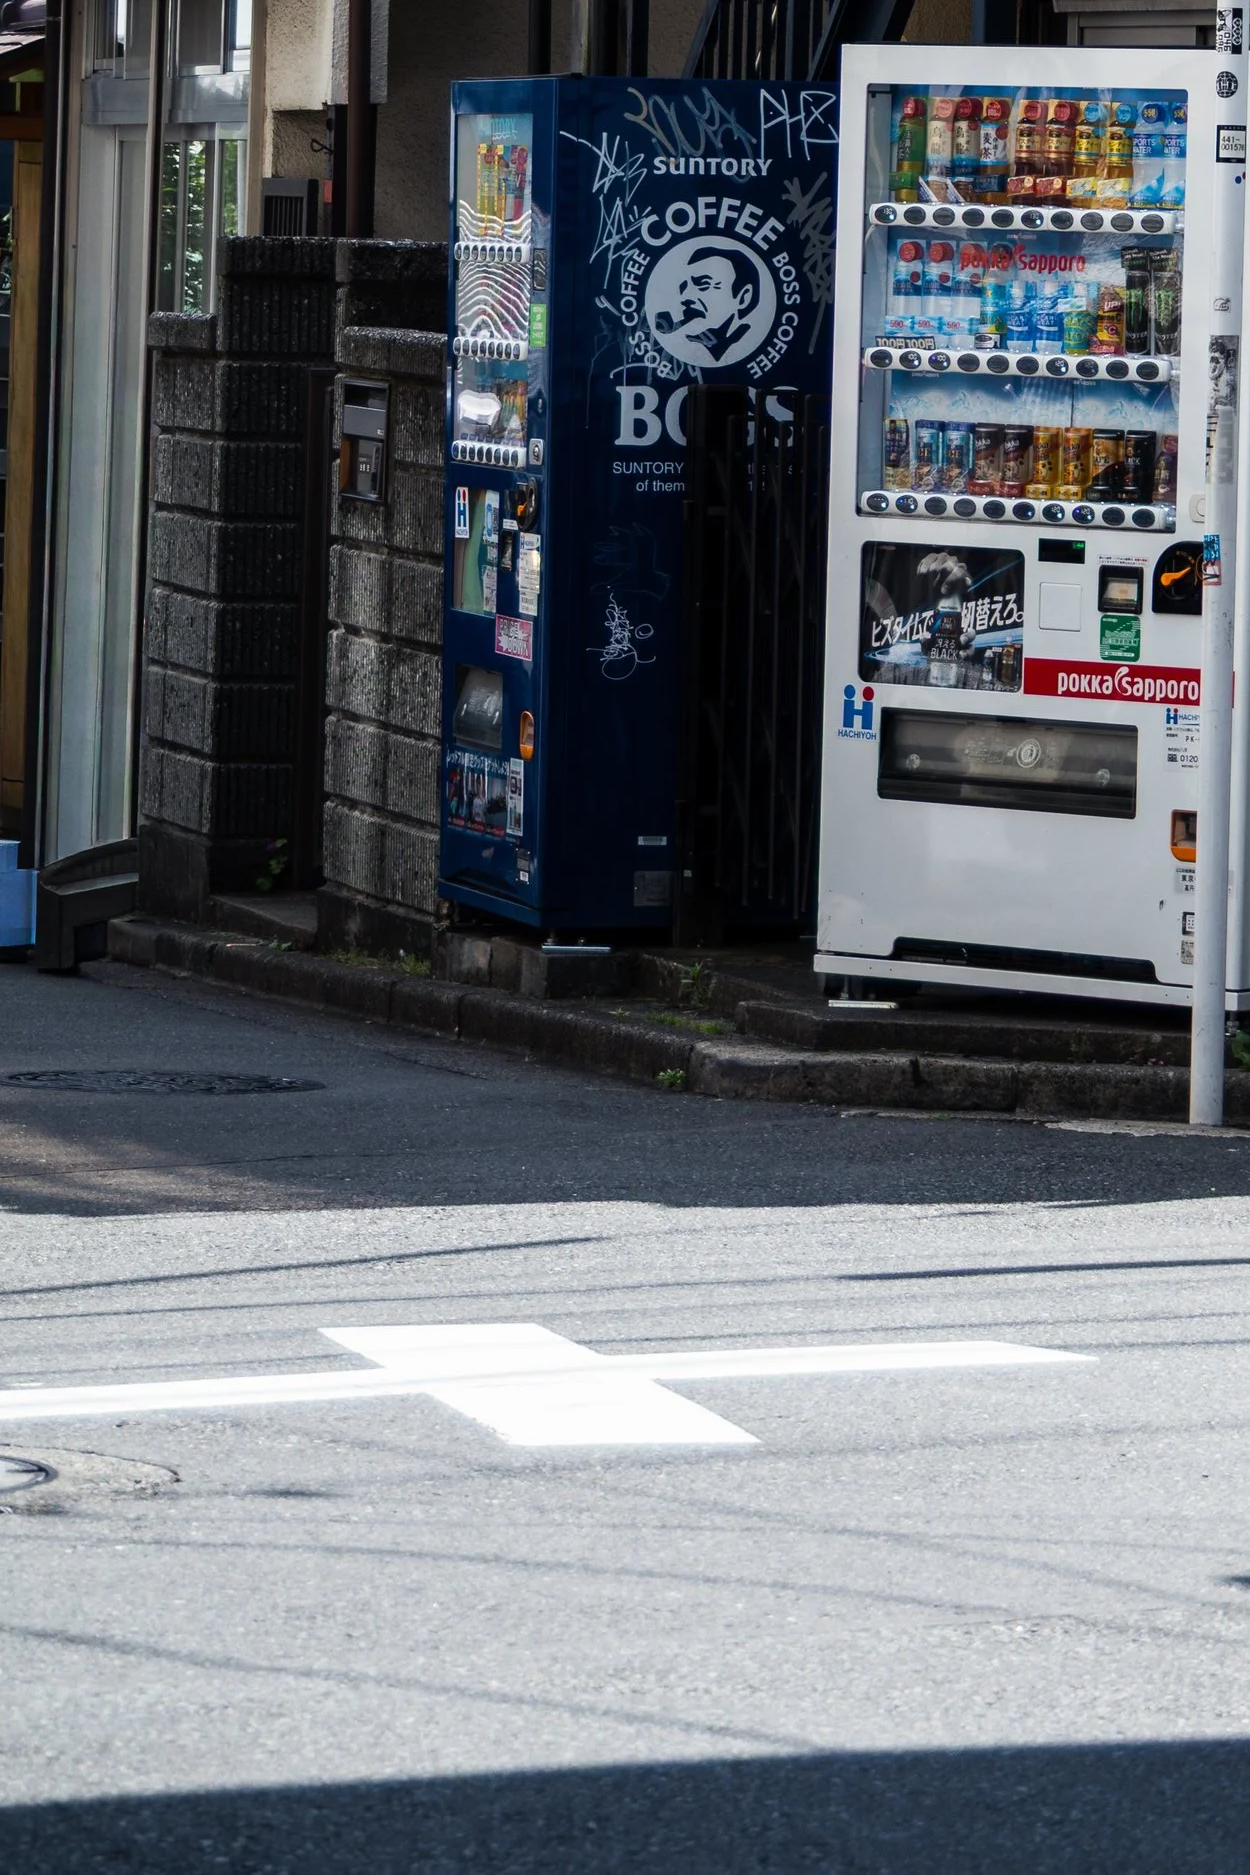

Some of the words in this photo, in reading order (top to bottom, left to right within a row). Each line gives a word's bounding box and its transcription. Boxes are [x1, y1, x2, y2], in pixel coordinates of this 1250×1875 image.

[981, 132, 993, 160] 麦茶
[641, 196, 785, 251] COFFEE
[620, 248, 650, 327] COFFEE
[772, 251, 800, 305] BOSS
[629, 331, 672, 378] BOSS
[746, 311, 799, 379] COFFEE
[877, 338, 904, 349] 100円
[906, 339, 934, 350] 100円
[612, 461, 685, 475] SUNTORY
[636, 479, 648, 491] of
[961, 593, 1024, 633] 切替えろ。
[871, 610, 936, 648] ビズタイムで
[935, 638, 956, 648] 冴える
[930, 648, 958, 660] BLACK
[837, 729, 877, 740] HACHIYOH
[1180, 755, 1199, 763] 0120
